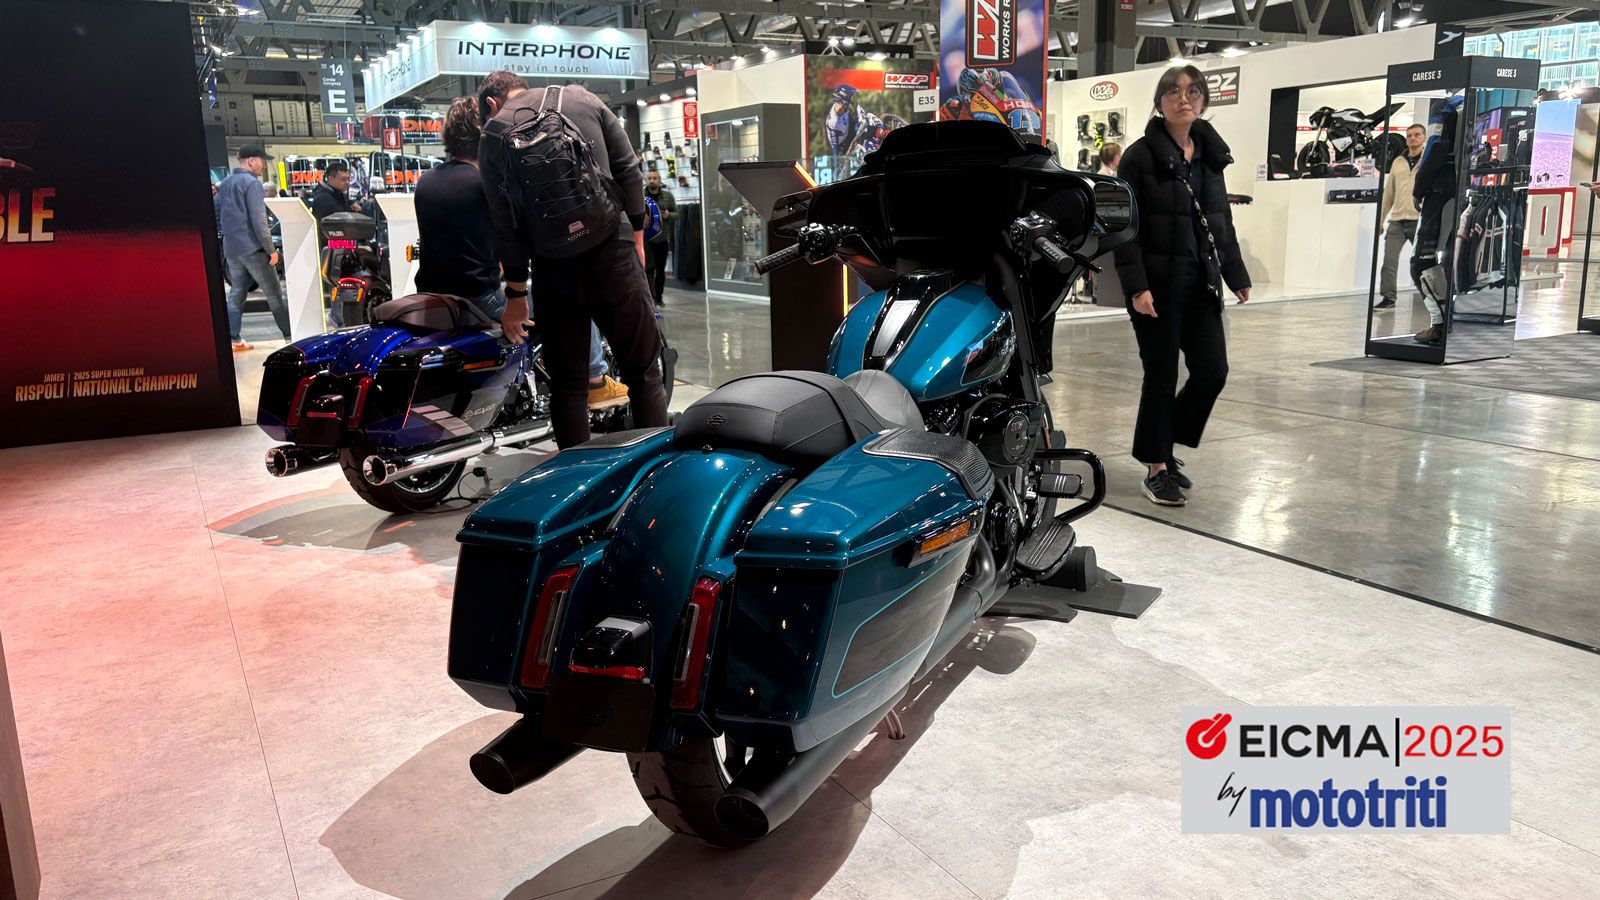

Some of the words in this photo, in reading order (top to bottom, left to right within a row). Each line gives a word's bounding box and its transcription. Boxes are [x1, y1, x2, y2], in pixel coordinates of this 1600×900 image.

[1002, 10, 1011, 59] WORKS
[458, 41, 631, 60] INTERPHONE
[329, 63, 345, 76] 14
[504, 64, 531, 73] stay
[537, 63, 548, 72] in
[554, 64, 589, 73] touch
[1496, 68, 1513, 77] CARESE
[885, 73, 929, 84] WRP
[1412, 71, 1436, 82] CARESE
[1436, 70, 1442, 79] 3
[328, 89, 348, 113] E
[918, 96, 936, 105] E35
[0, 186, 56, 242] LE
[43, 373, 65, 383] JAMES
[74, 371, 91, 380] 2025
[91, 370, 112, 379] SUPER
[112, 368, 144, 378] HOOLIGAN
[73, 378, 132, 397] NATIONAL
[134, 374, 198, 393] CHAMPION
[15, 383, 65, 402] RISPOLI
